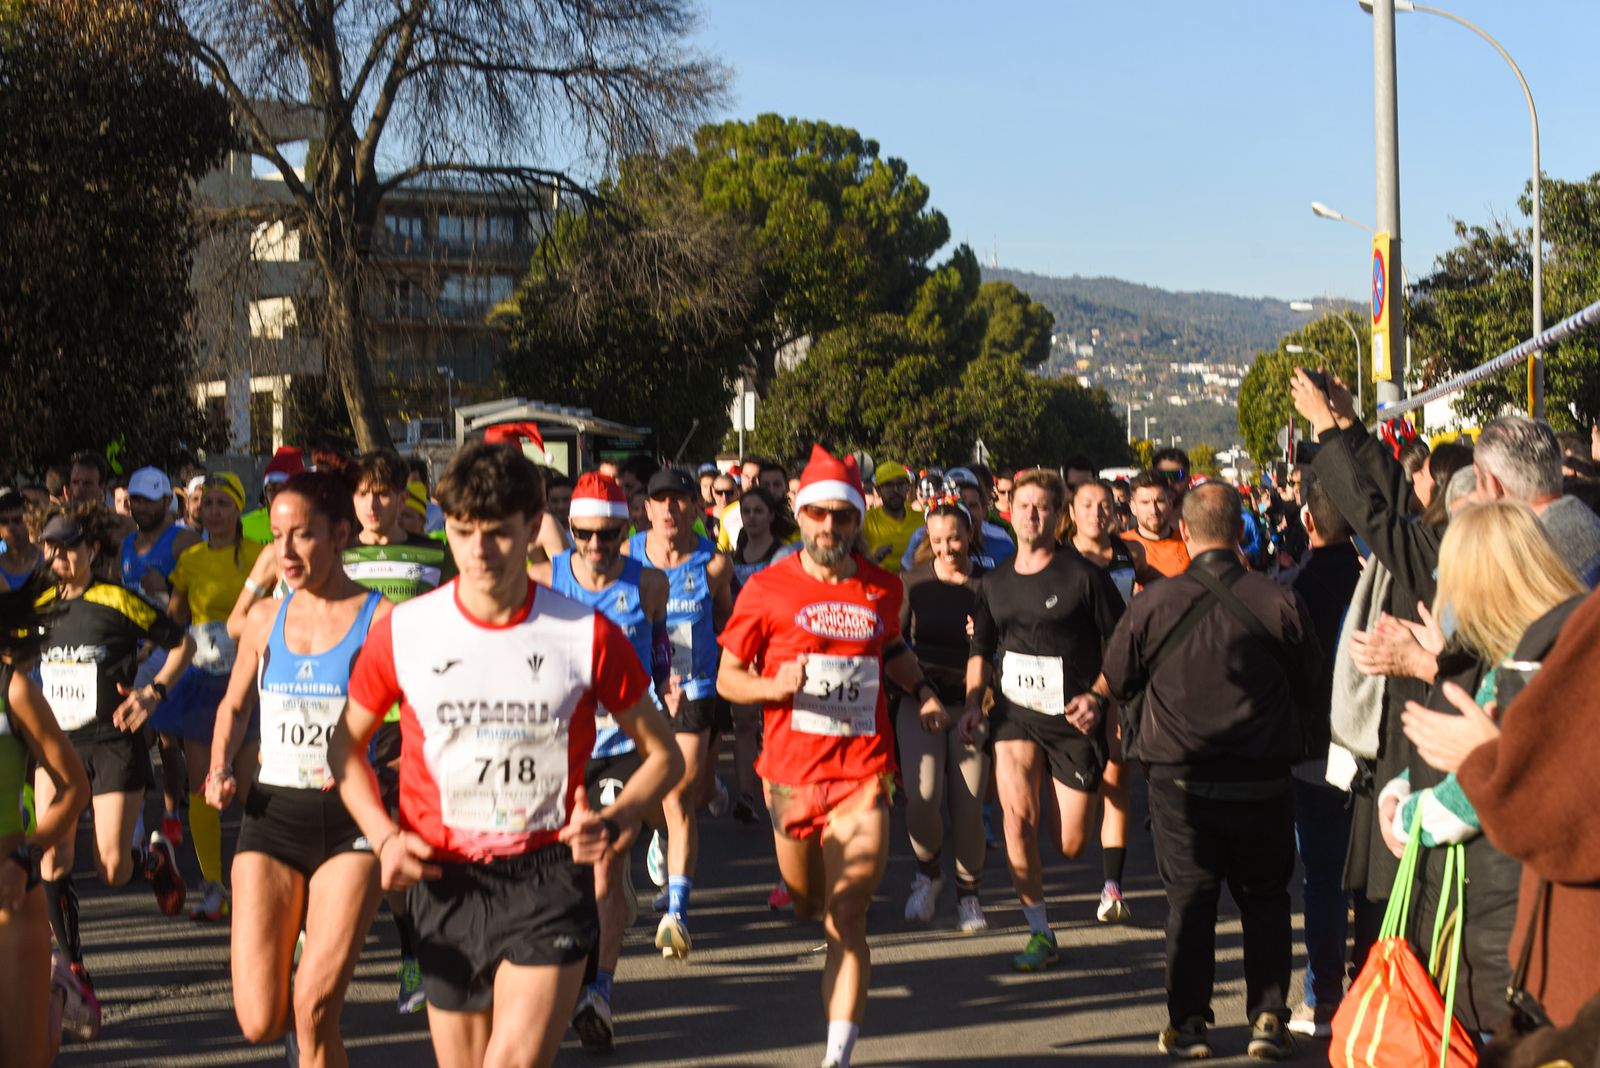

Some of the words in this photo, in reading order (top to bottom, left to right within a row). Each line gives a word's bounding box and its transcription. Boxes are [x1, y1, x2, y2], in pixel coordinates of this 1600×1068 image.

[805, 603, 829, 617] BANK
[829, 602, 841, 614] OF
[842, 602, 877, 623] AMERICA
[817, 611, 869, 630] CHICAGO
[811, 617, 875, 639] MARATHON
[50, 683, 86, 701] 1496
[268, 682, 342, 696] TROTASIERRA
[818, 680, 861, 703] 315
[1017, 673, 1046, 691] 193
[436, 700, 549, 725] CYMRU
[474, 756, 537, 785] 718
